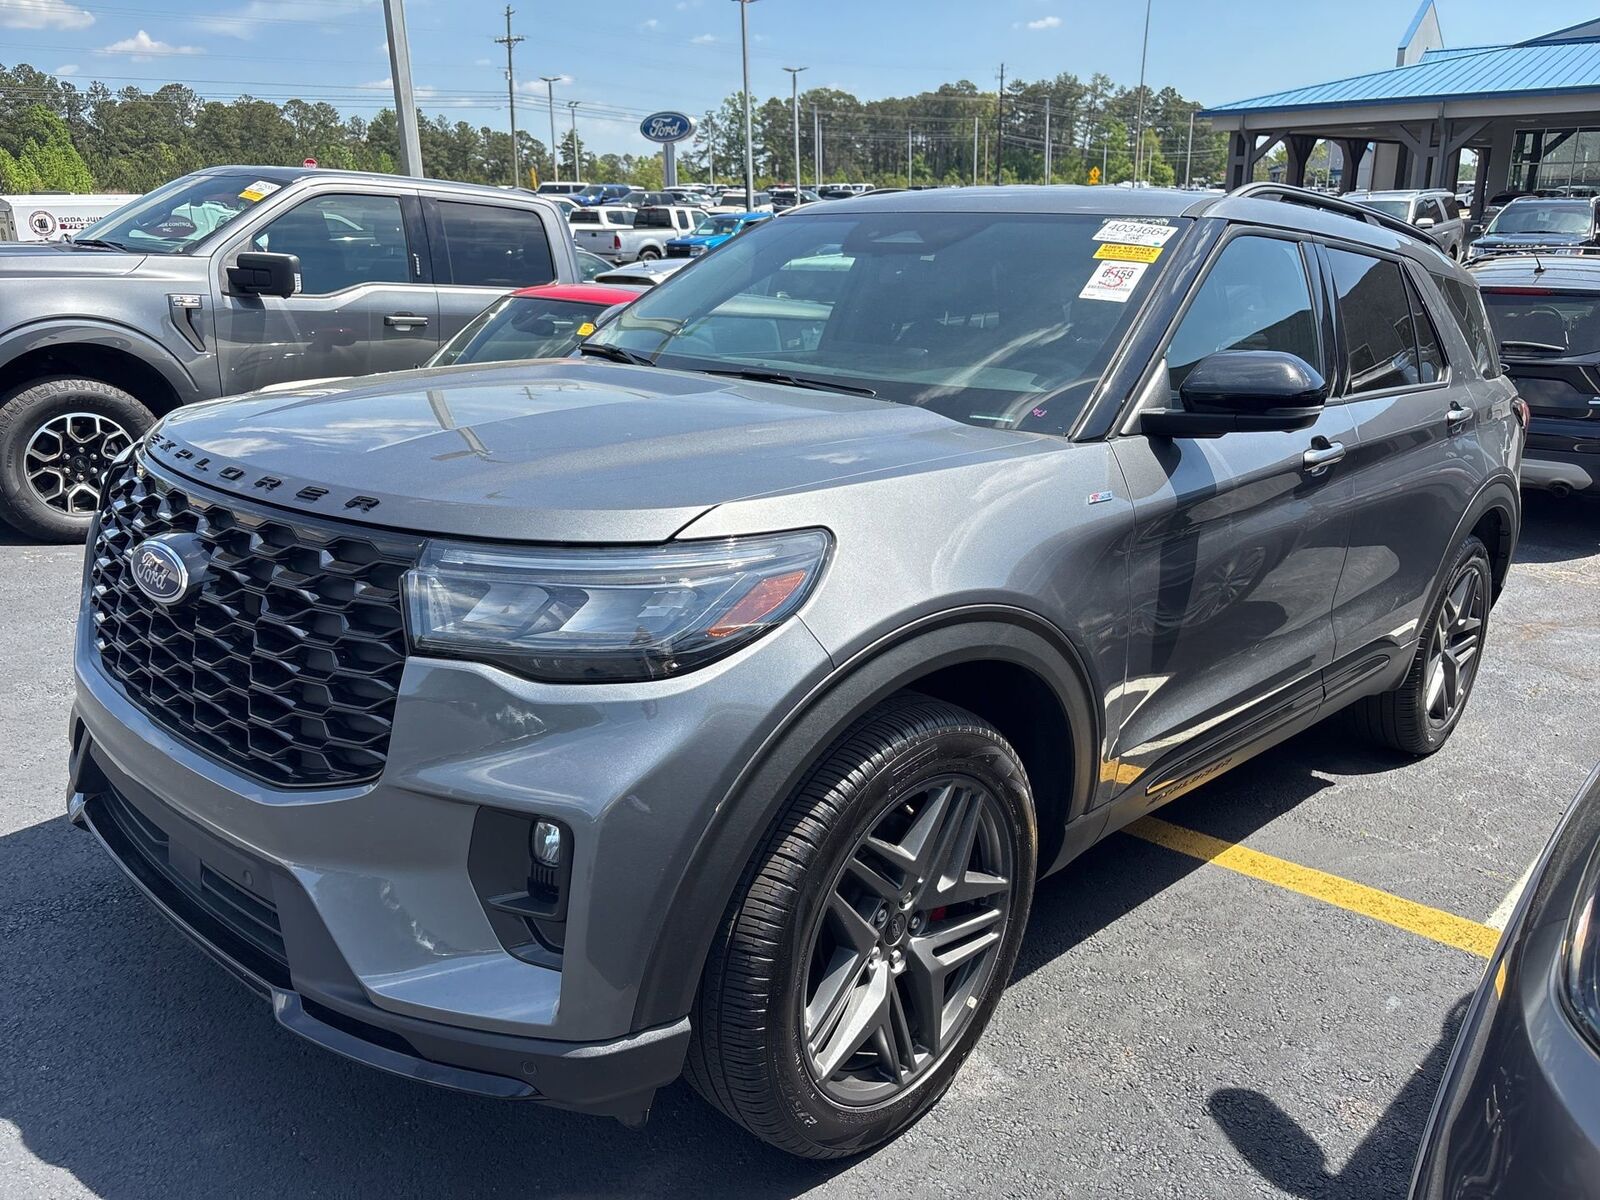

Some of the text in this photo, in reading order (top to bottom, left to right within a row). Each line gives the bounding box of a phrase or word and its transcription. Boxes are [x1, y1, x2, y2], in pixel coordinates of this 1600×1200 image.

[649, 117, 681, 137] Ford
[1108, 223, 1171, 237] 4034664
[150, 433, 380, 512] EXPLORER
[137, 551, 170, 590] Ford
